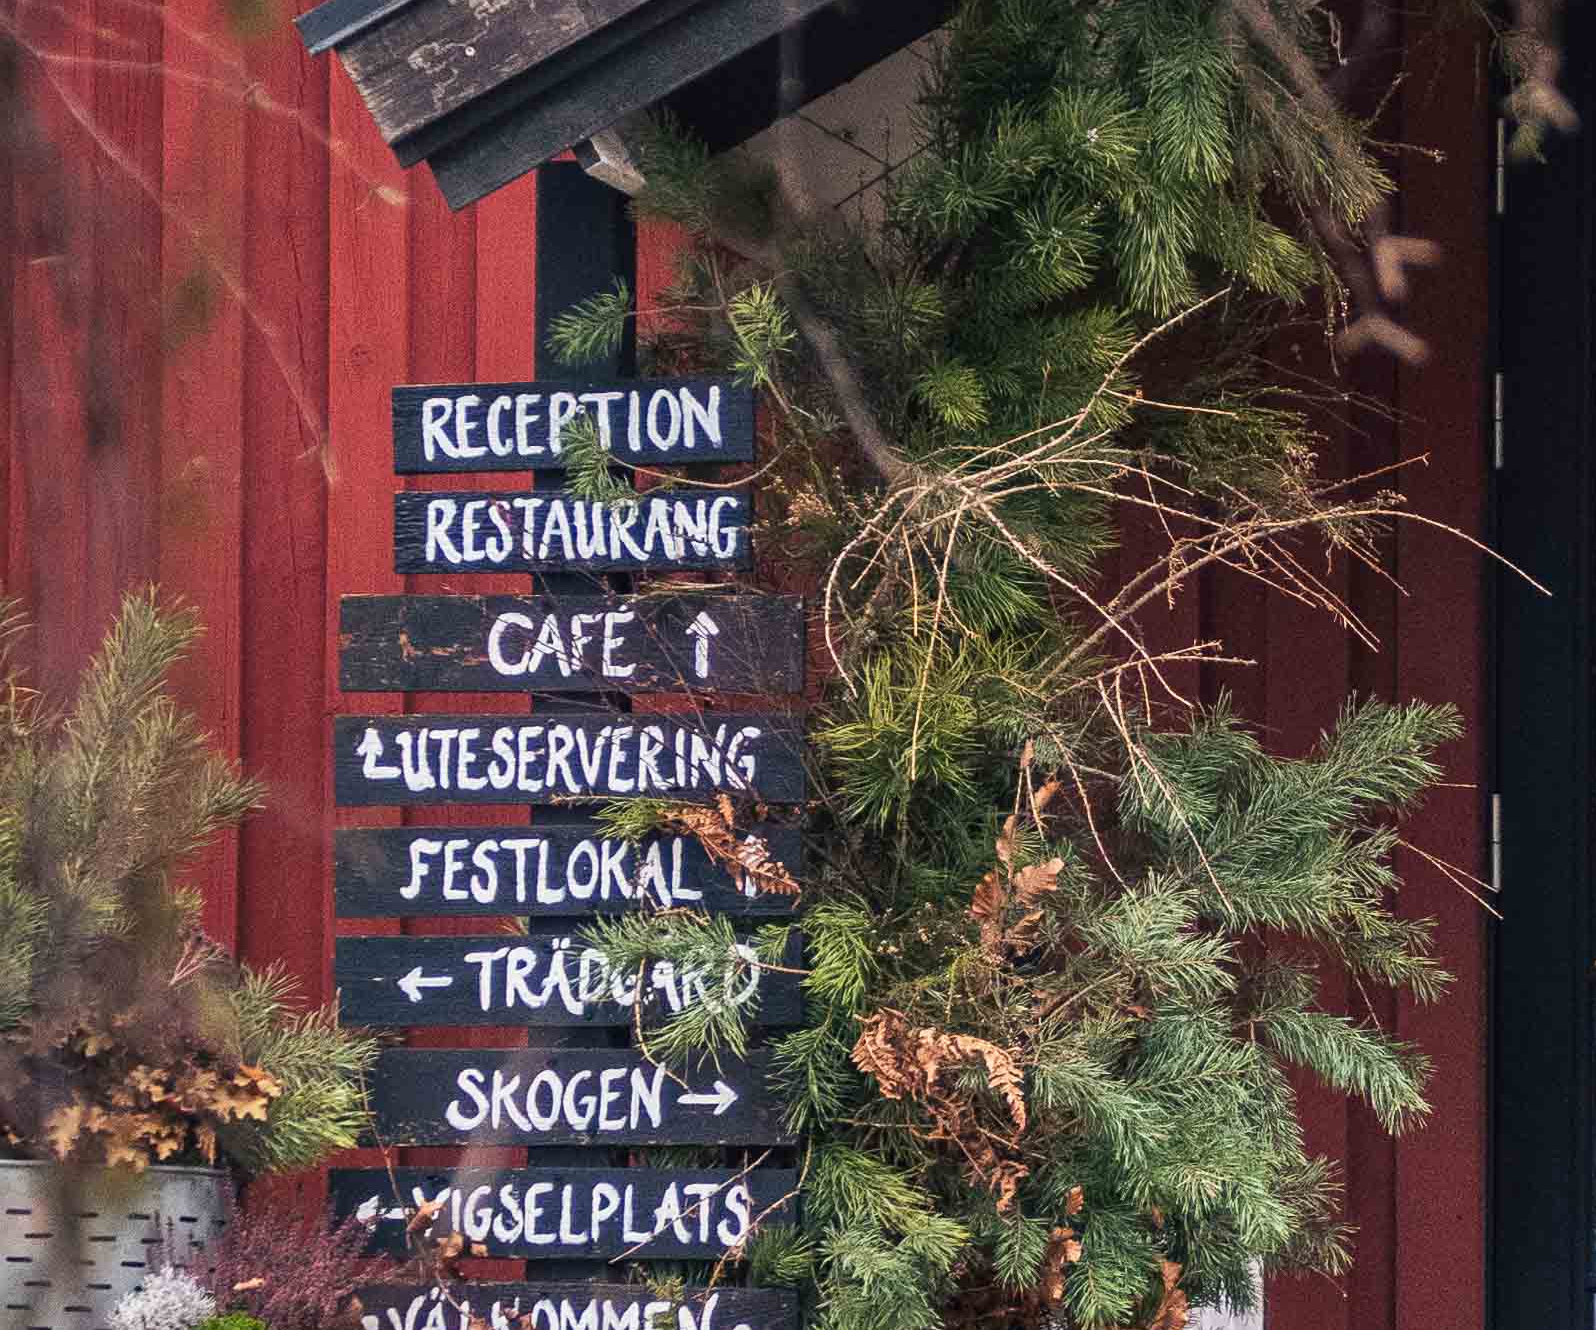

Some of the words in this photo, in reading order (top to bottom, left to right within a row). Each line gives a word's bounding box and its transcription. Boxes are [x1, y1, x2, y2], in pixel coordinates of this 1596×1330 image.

[422, 385, 722, 461] RECEPTION
[425, 494, 740, 563] RESTAURANG
[487, 605, 636, 677] CAFÉ
[395, 724, 762, 793] UTESERVERING
[400, 836, 703, 906] FESTLOKAL
[445, 1065, 666, 1131] SKOGEN
